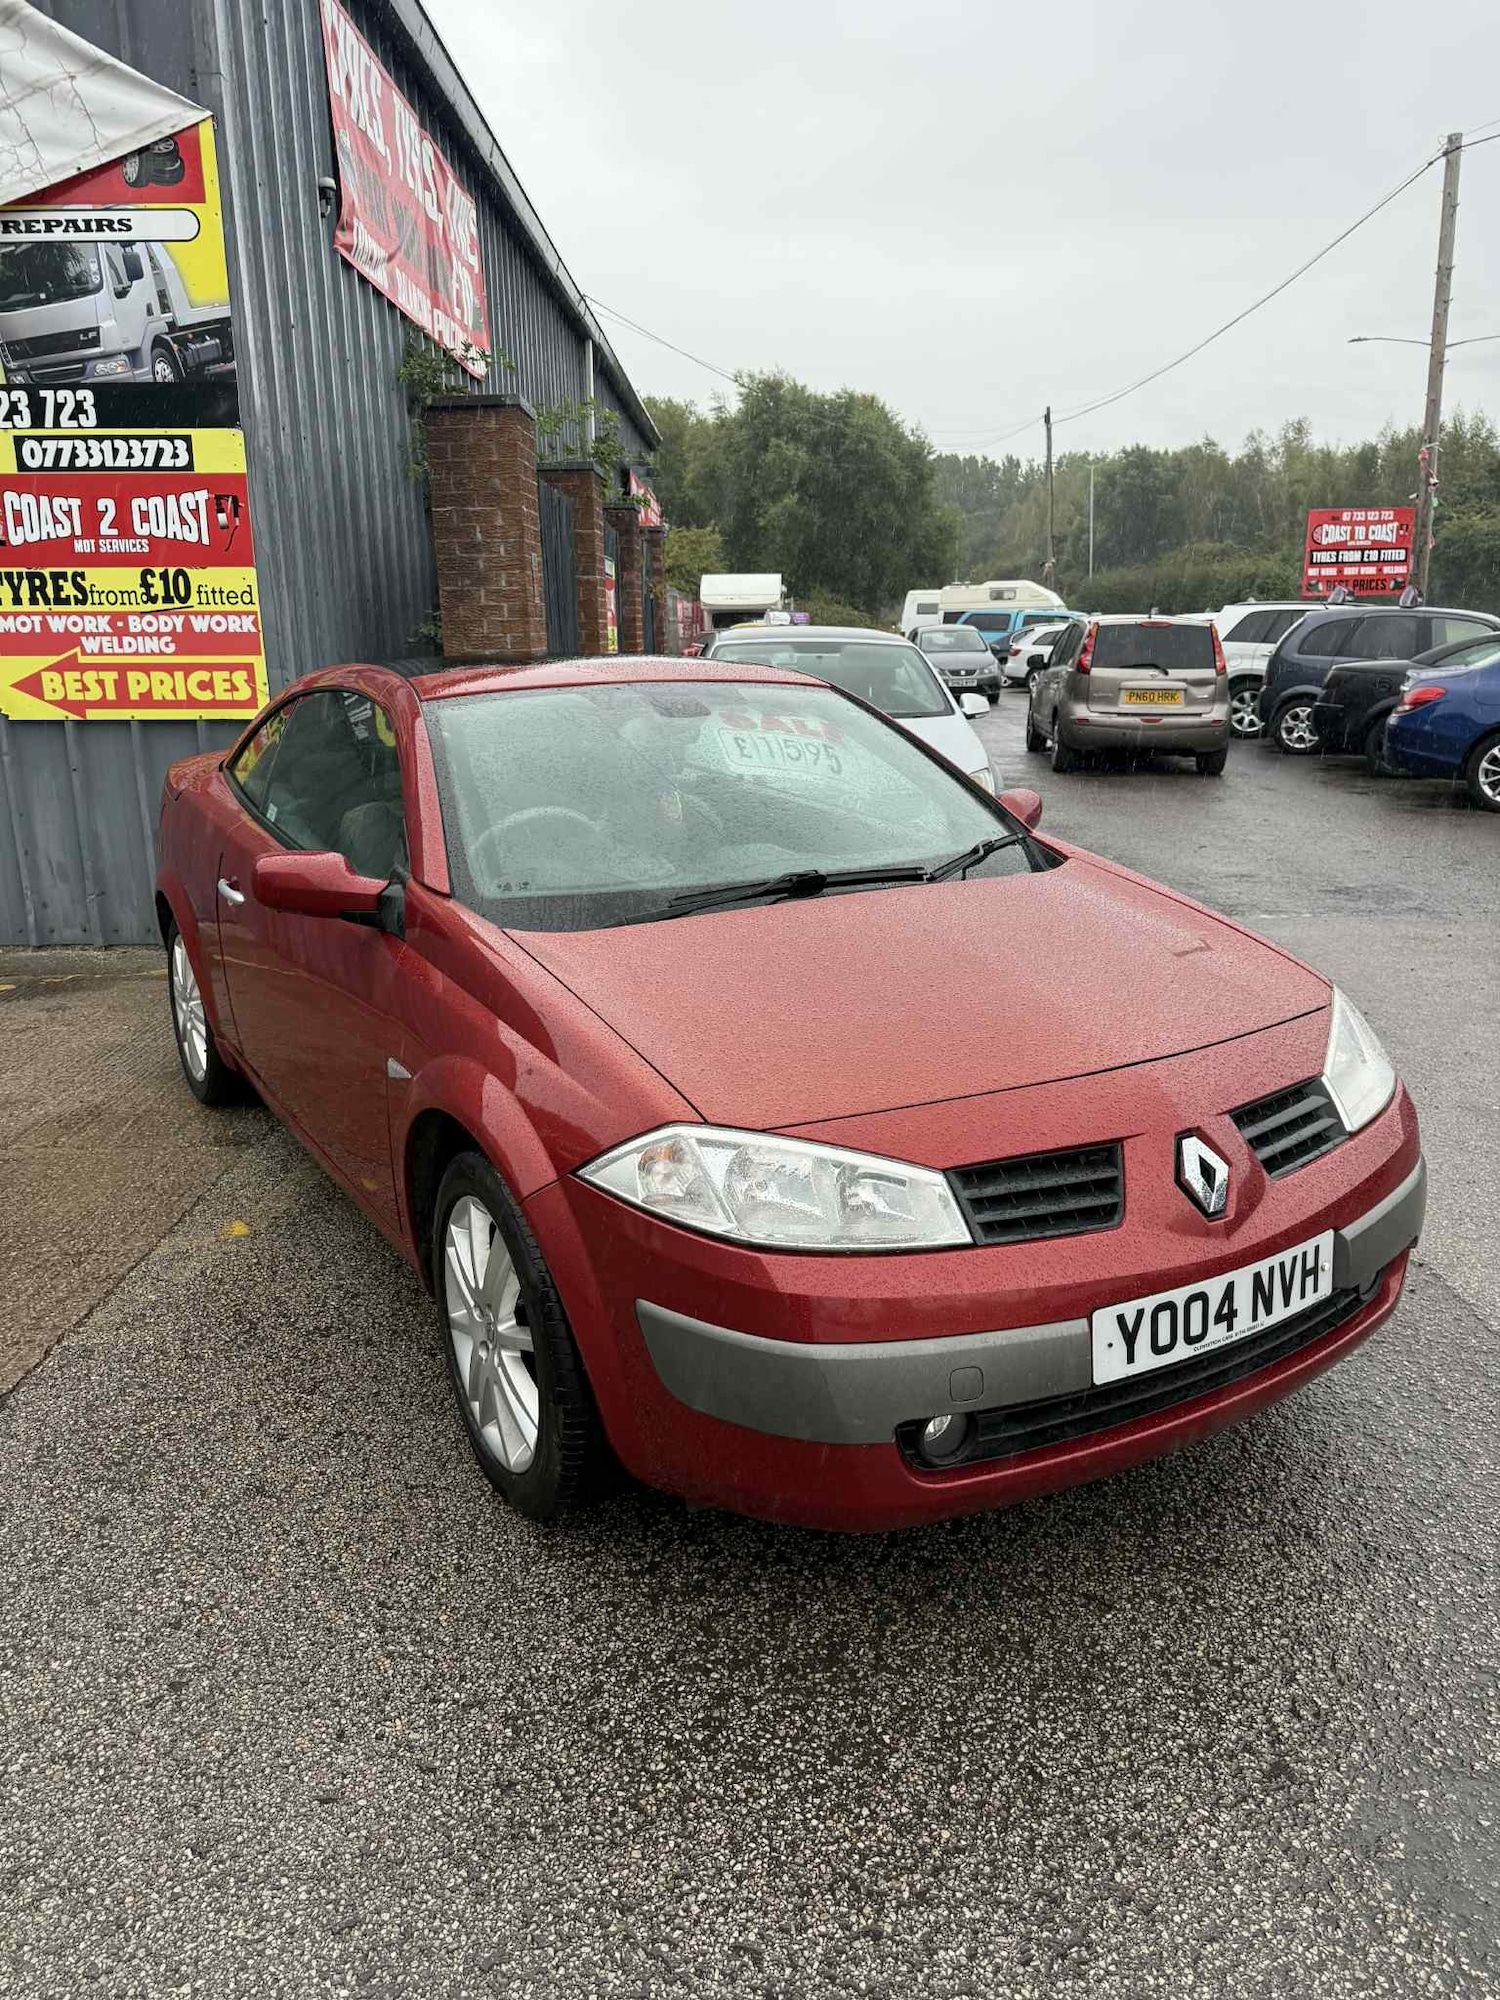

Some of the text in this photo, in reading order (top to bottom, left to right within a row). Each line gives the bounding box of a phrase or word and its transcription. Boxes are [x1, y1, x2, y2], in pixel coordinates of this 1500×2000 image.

[1, 218, 133, 235] REPAIRS
[39, 389, 97, 428] 723
[22, 439, 189, 468] 07733123723
[3, 489, 210, 546] COAST 2 COAST
[1321, 521, 1399, 545] COAST TO COAST
[74, 539, 149, 553] MOT SERVICES
[1312, 549, 1406, 563] TYRES FROM £10 FITTED
[0, 568, 255, 606] YRES from £10 fitted
[1353, 579, 1387, 591] PRICES
[0, 615, 42, 633] MOT
[46, 615, 113, 633] WORK
[128, 615, 185, 633] BODY
[189, 615, 257, 633] WORK
[80, 636, 176, 654] WELDING
[41, 671, 251, 701] BEST PRICES
[1128, 691, 1178, 703] PN60 HRK
[1116, 1244, 1320, 1364] YO04 NVH
